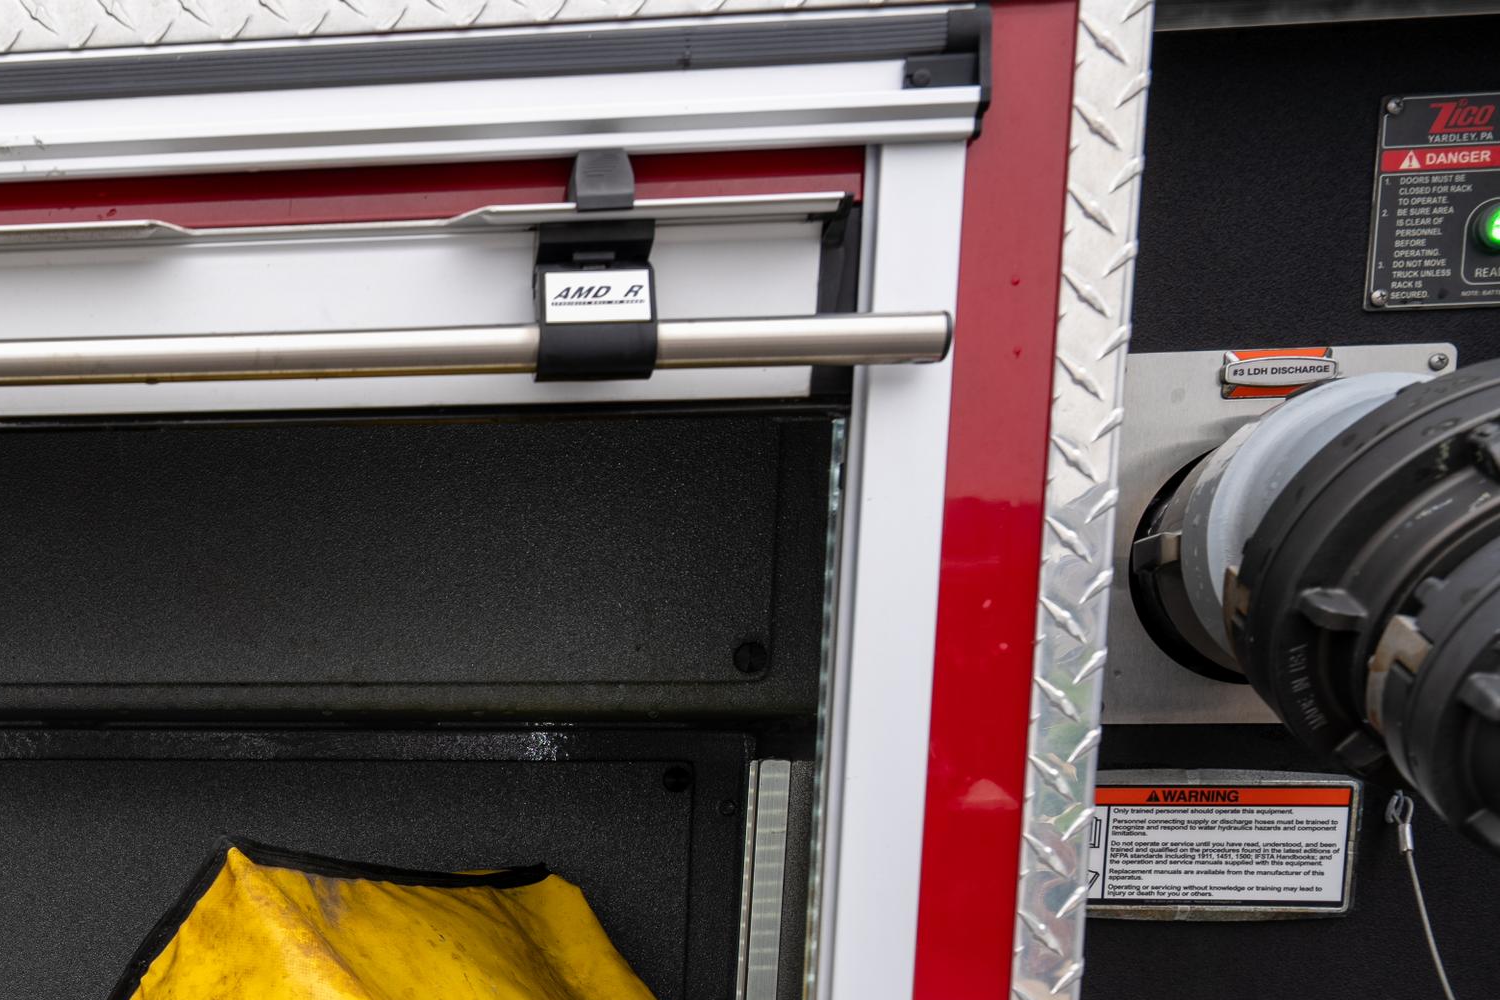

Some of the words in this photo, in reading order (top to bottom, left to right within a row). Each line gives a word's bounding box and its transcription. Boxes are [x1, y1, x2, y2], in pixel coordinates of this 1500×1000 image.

[1428, 99, 1495, 133] Zico
[1480, 131, 1493, 140] PA
[1426, 150, 1491, 165] DANGER
[1399, 186, 1430, 195] CLOSED
[1432, 185, 1448, 193] FOR
[1410, 208, 1430, 216] SURE
[1396, 228, 1442, 237] PERSONNEL
[1395, 239, 1426, 247] BEFORE
[1421, 269, 1451, 277] UNLESS
[1248, 368, 1268, 376] LDH
[1270, 365, 1330, 374] DISCHARGE
[1162, 790, 1239, 802] WARNING
